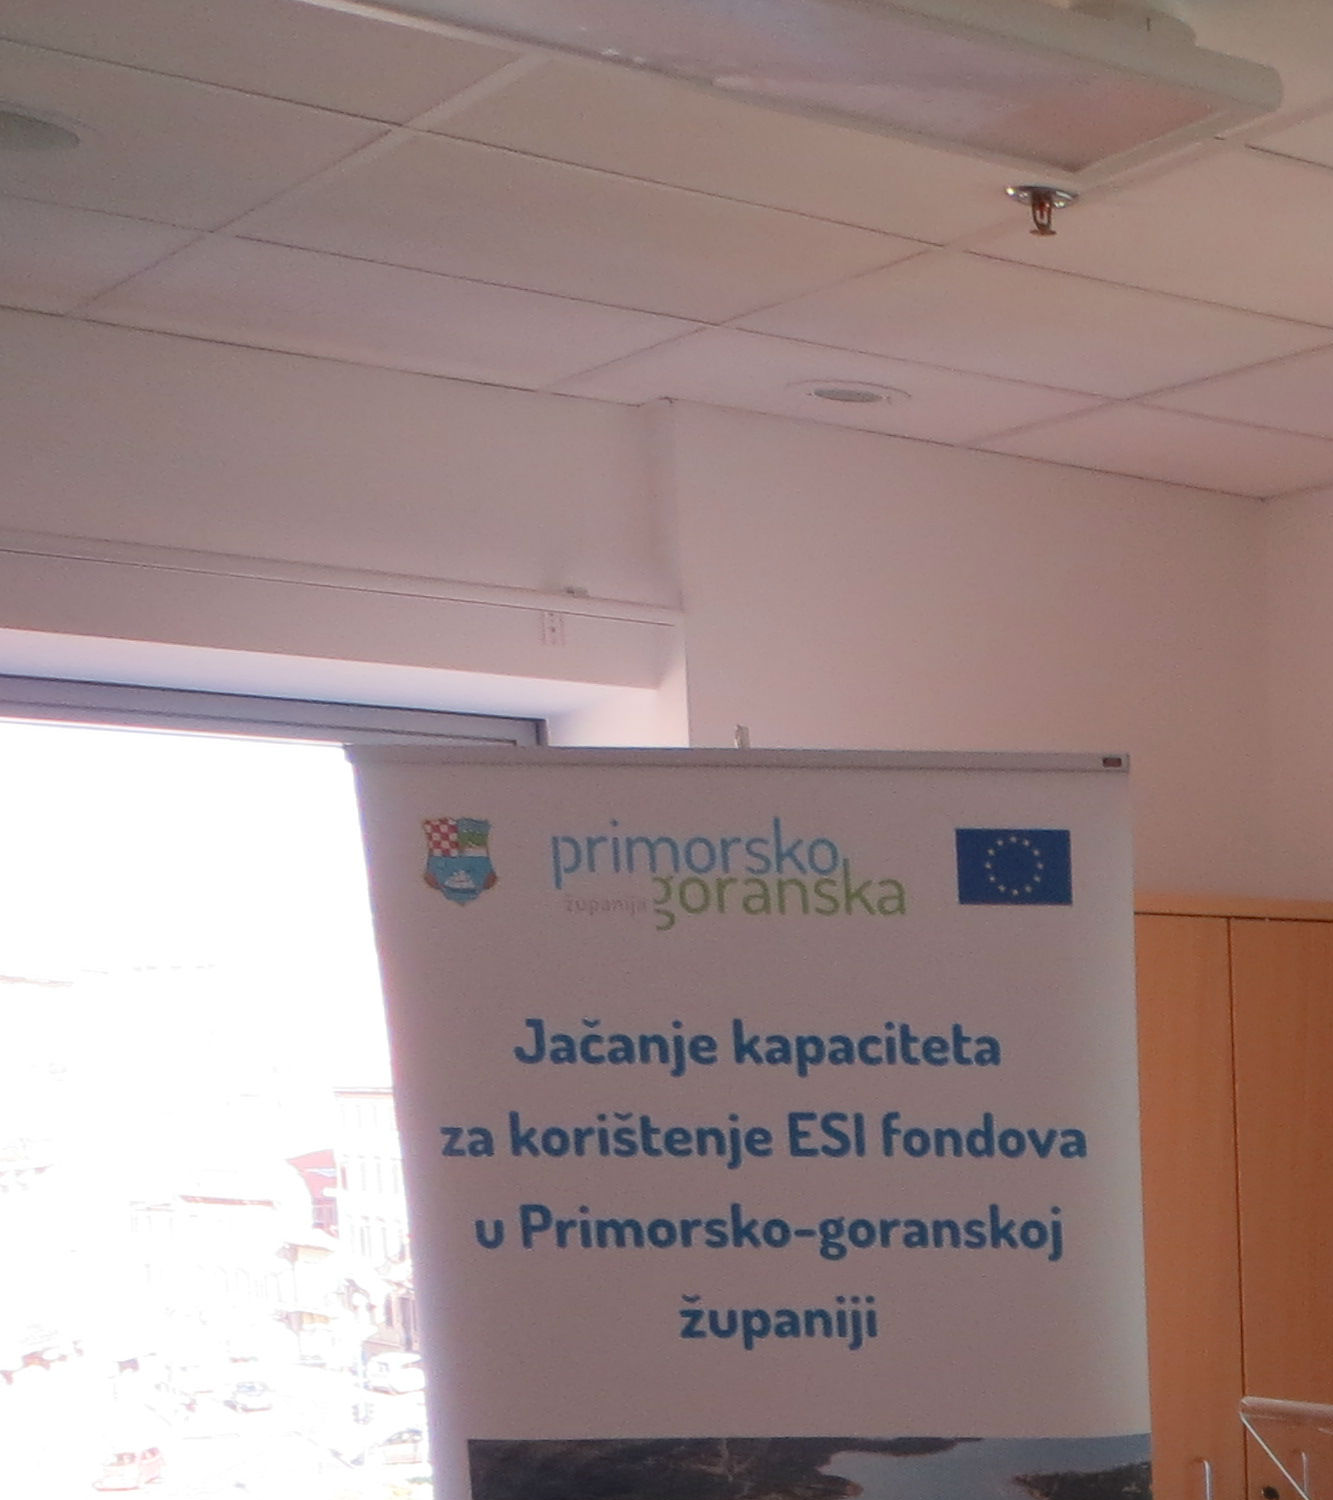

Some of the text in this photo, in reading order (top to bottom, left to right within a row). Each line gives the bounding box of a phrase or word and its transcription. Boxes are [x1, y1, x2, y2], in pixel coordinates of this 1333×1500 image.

[550, 816, 842, 889] primorsko
[652, 857, 908, 931] goranska
[513, 1017, 1002, 1078] Jačanje kapaciteta
[440, 1111, 1088, 1169] za korištenje ESI fondova
[475, 1203, 1064, 1261] u Primorsko-goranskoj
[680, 1295, 879, 1350] županiji
